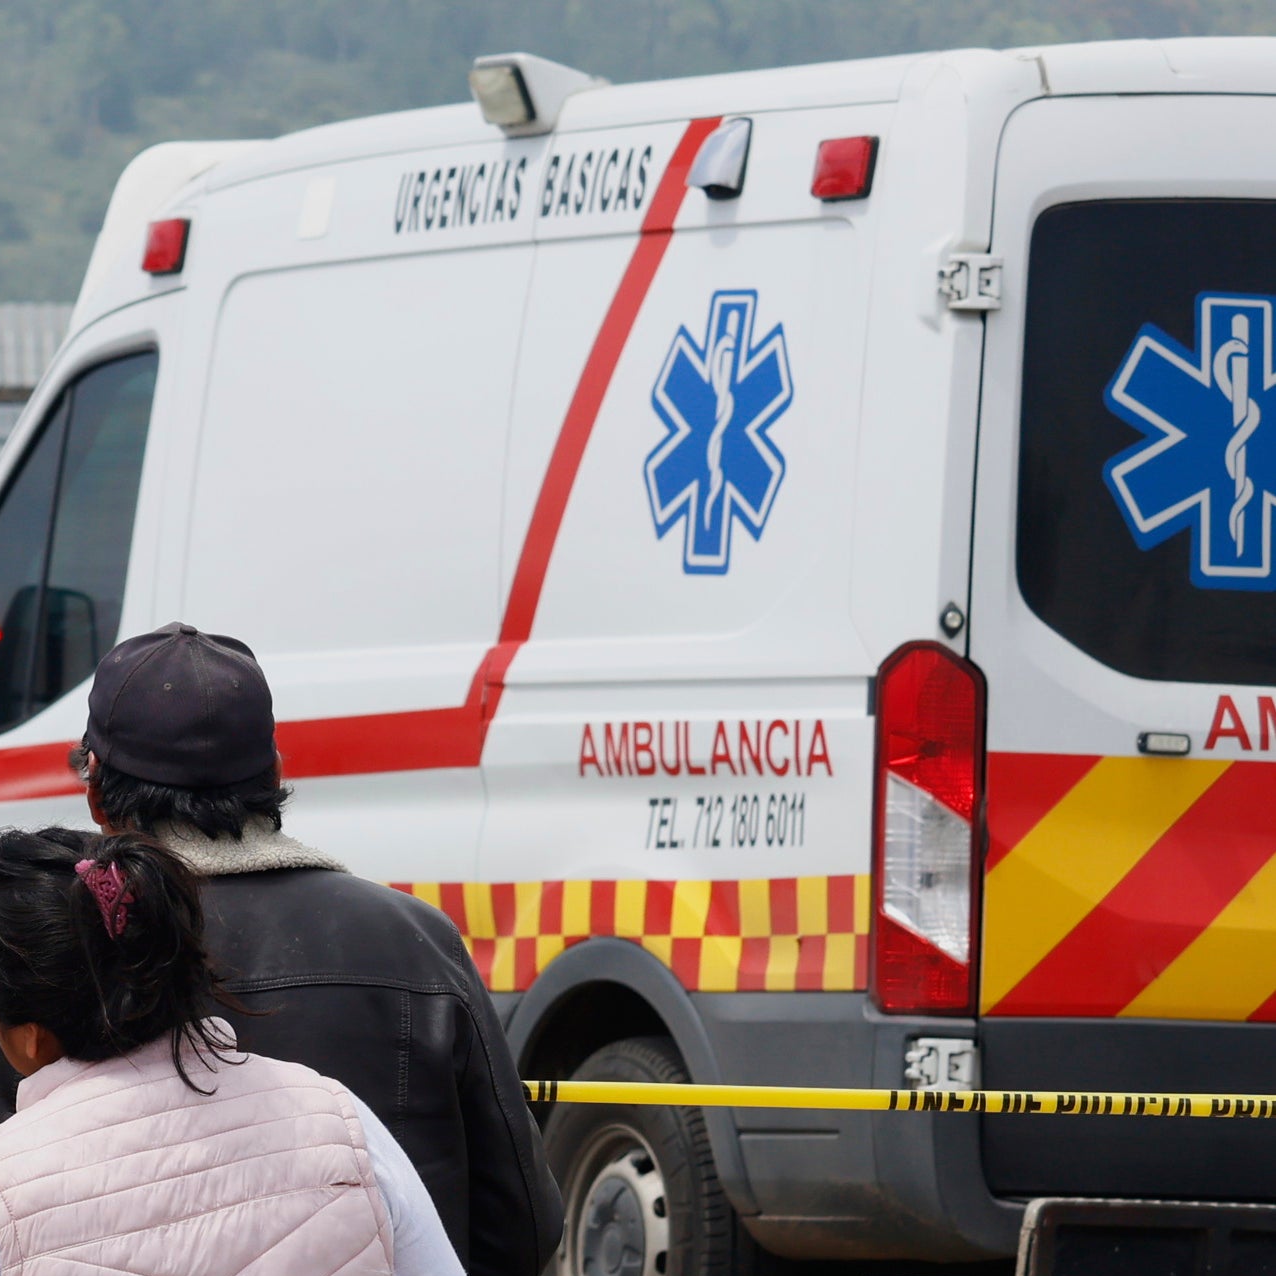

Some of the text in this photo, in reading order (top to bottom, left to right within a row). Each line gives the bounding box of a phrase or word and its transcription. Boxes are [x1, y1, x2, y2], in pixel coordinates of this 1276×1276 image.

[394, 144, 653, 235] URGENCIAS BASICAS
[579, 719, 834, 778] AMBULANCIA
[644, 792, 806, 849] TEL. 712 180 6011
